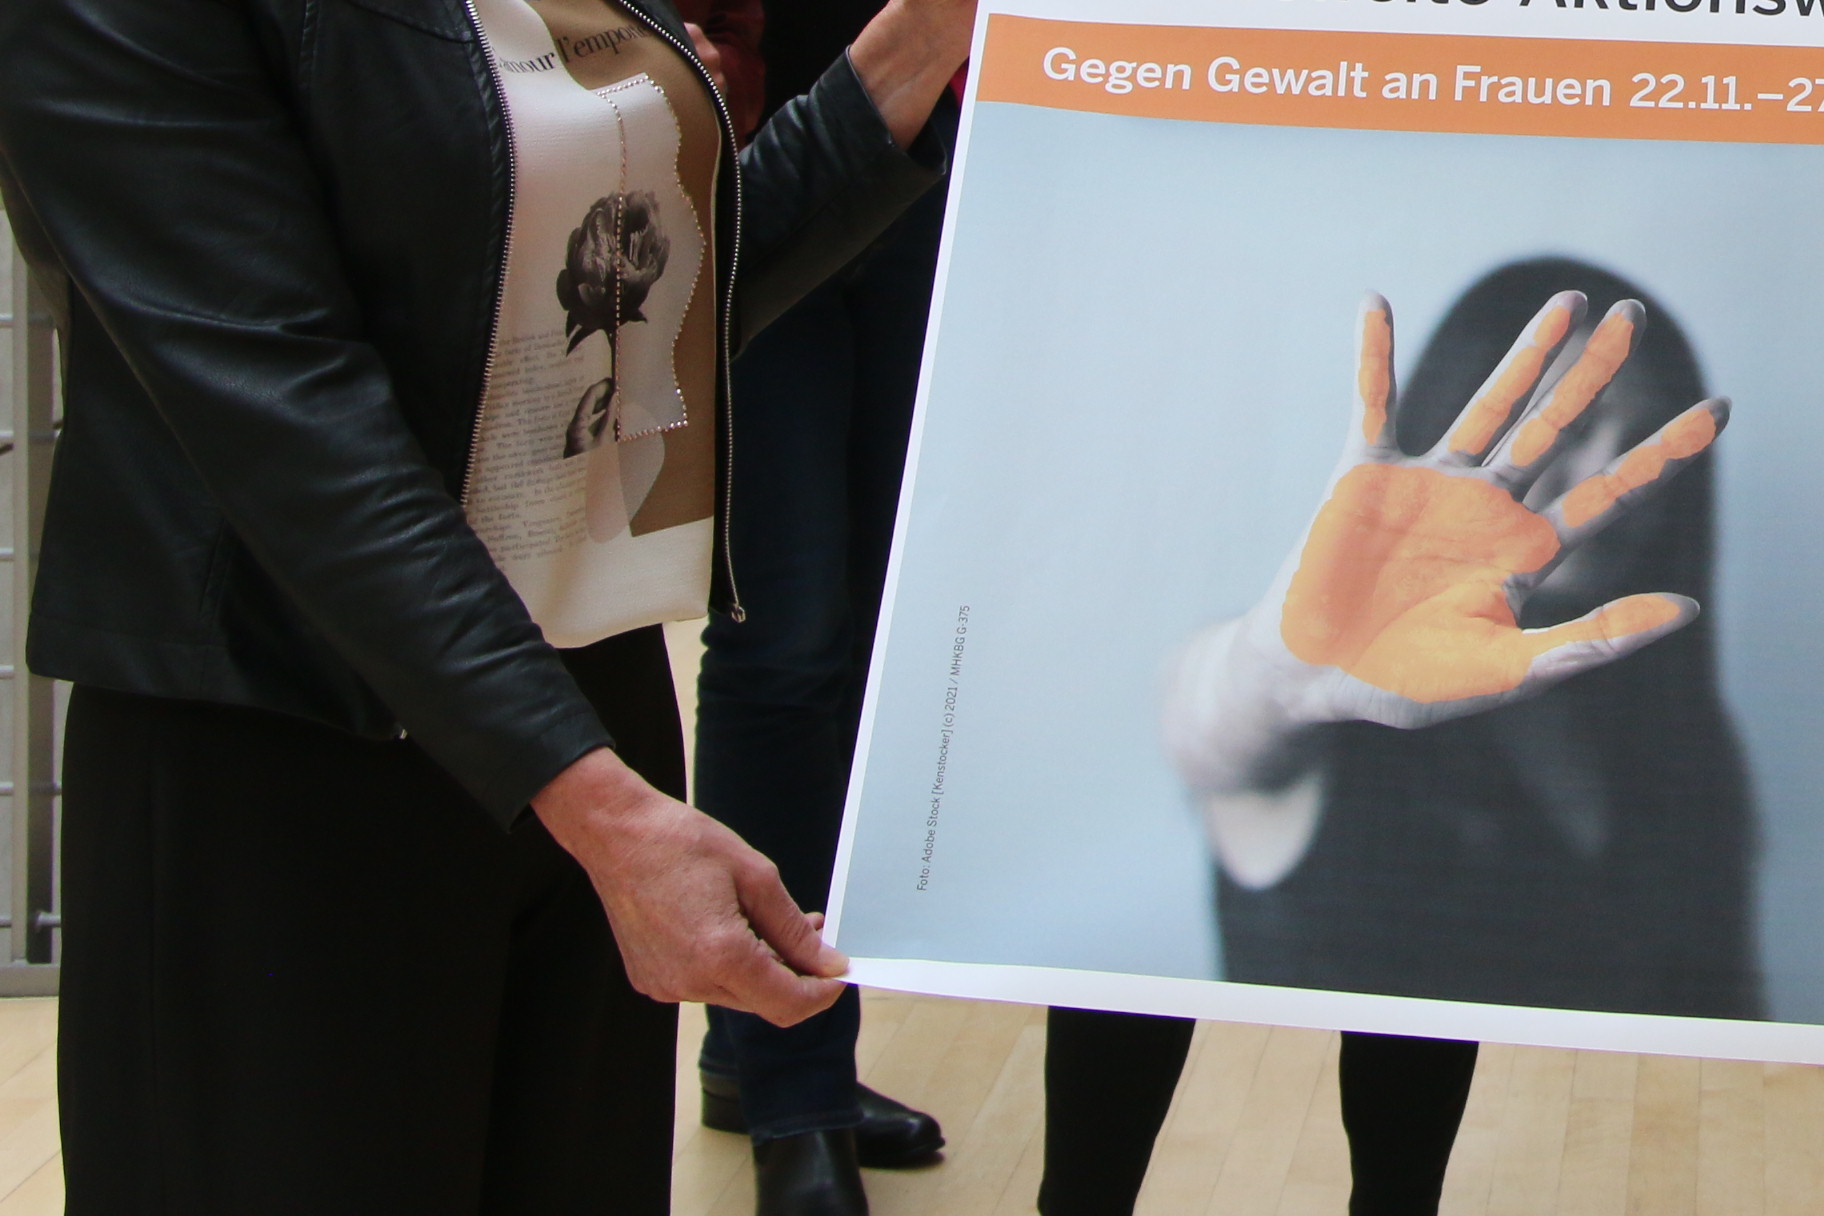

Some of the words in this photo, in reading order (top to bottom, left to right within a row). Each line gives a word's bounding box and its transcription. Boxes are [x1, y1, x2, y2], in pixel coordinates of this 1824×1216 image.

[1043, 46, 1192, 94] Gegen
[1207, 56, 1370, 98] Gewalt
[1381, 72, 1438, 100] an
[1454, 64, 1611, 107] Frauen
[956, 605, 970, 635] G-375
[950, 636, 966, 677] MHKBG
[944, 686, 958, 712] 2021
[942, 712, 956, 728] (c)
[931, 728, 955, 796] [Kenstocker]
[926, 797, 942, 828] Stock
[920, 829, 936, 864] Adobe
[916, 864, 932, 892] Foto:
